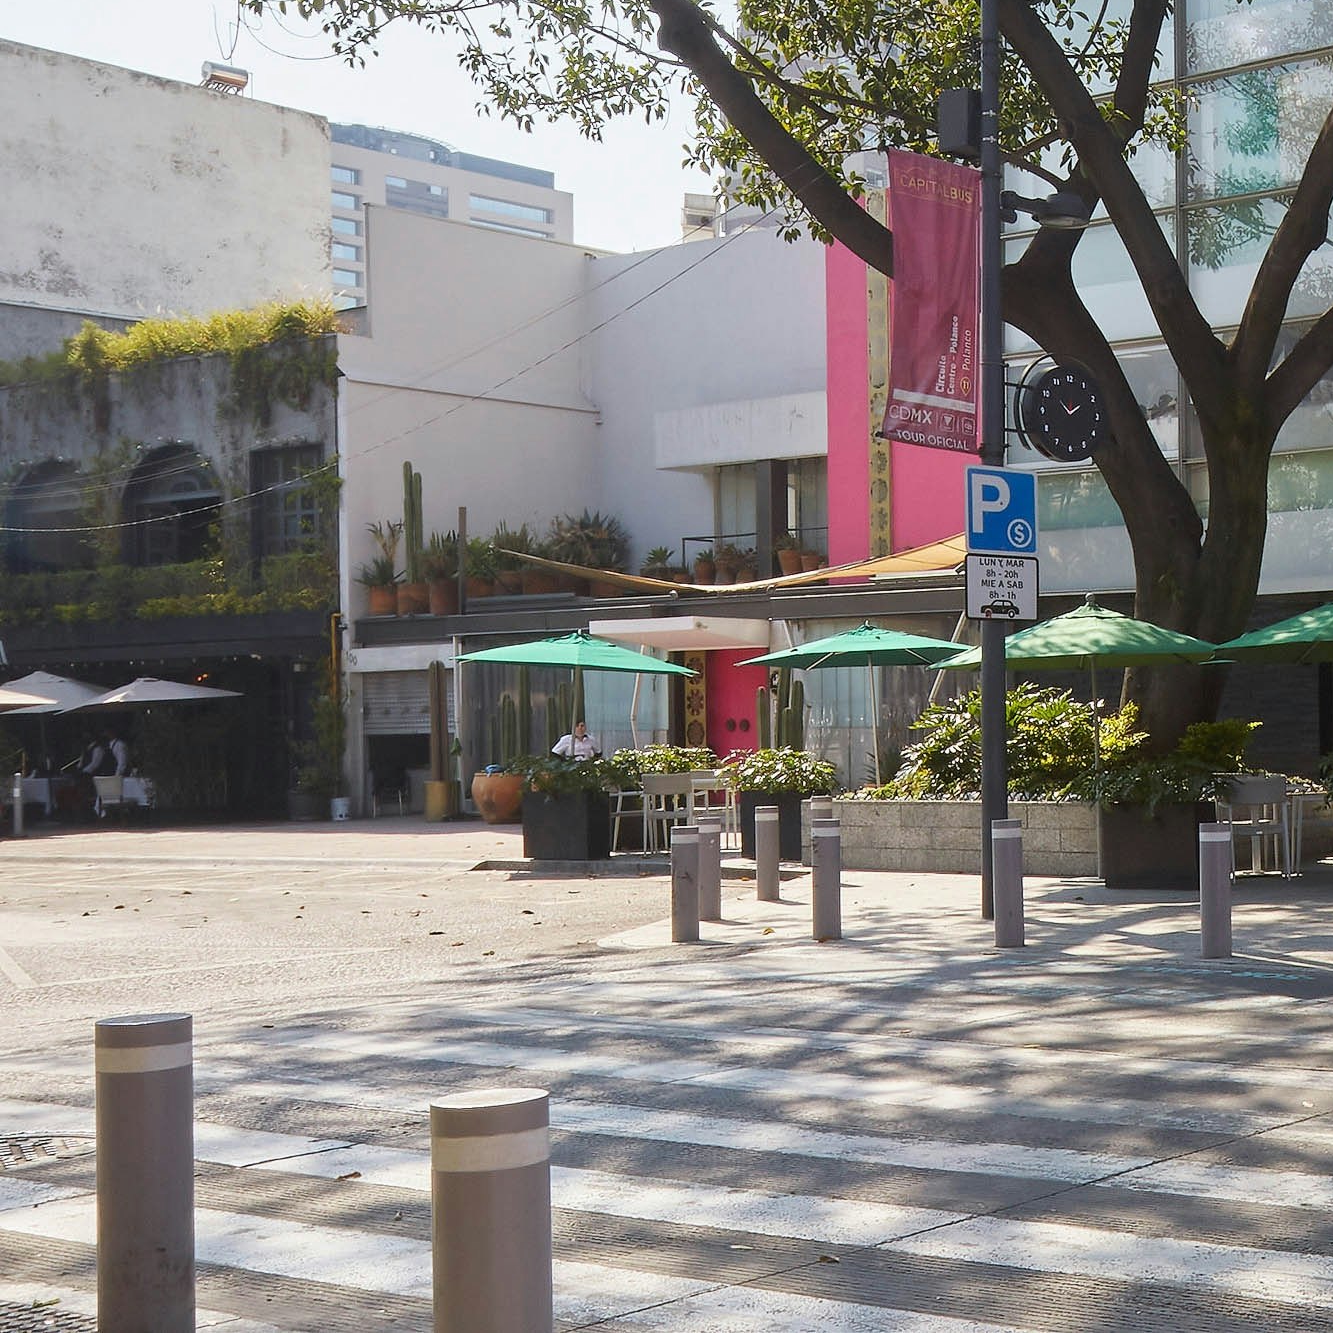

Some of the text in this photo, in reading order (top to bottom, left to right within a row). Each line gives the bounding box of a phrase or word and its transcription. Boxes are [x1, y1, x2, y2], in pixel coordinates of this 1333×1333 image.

[900, 174, 973, 204] CAPITALBUS
[950, 315, 958, 353] Polanco
[962, 330, 971, 371] Polanco
[936, 355, 946, 393] Circuito
[947, 363, 956, 395] Centro
[1066, 375, 1073, 383] 12
[1042, 389, 1050, 398] 10
[1090, 395, 1096, 403] 2
[889, 405, 932, 424] CDMX
[1040, 406, 1045, 415] 9
[1095, 413, 1100, 421] 3
[1091, 430, 1096, 438] 4
[896, 429, 970, 451] TOUR OFICIAL
[1081, 441, 1087, 449] 5
[972, 474, 1010, 534] P
[979, 557, 1025, 568] LUN Y MAR
[986, 569, 996, 577] 8h
[1004, 570, 1019, 578] 20h
[981, 579, 1024, 589] MIE A SAB
